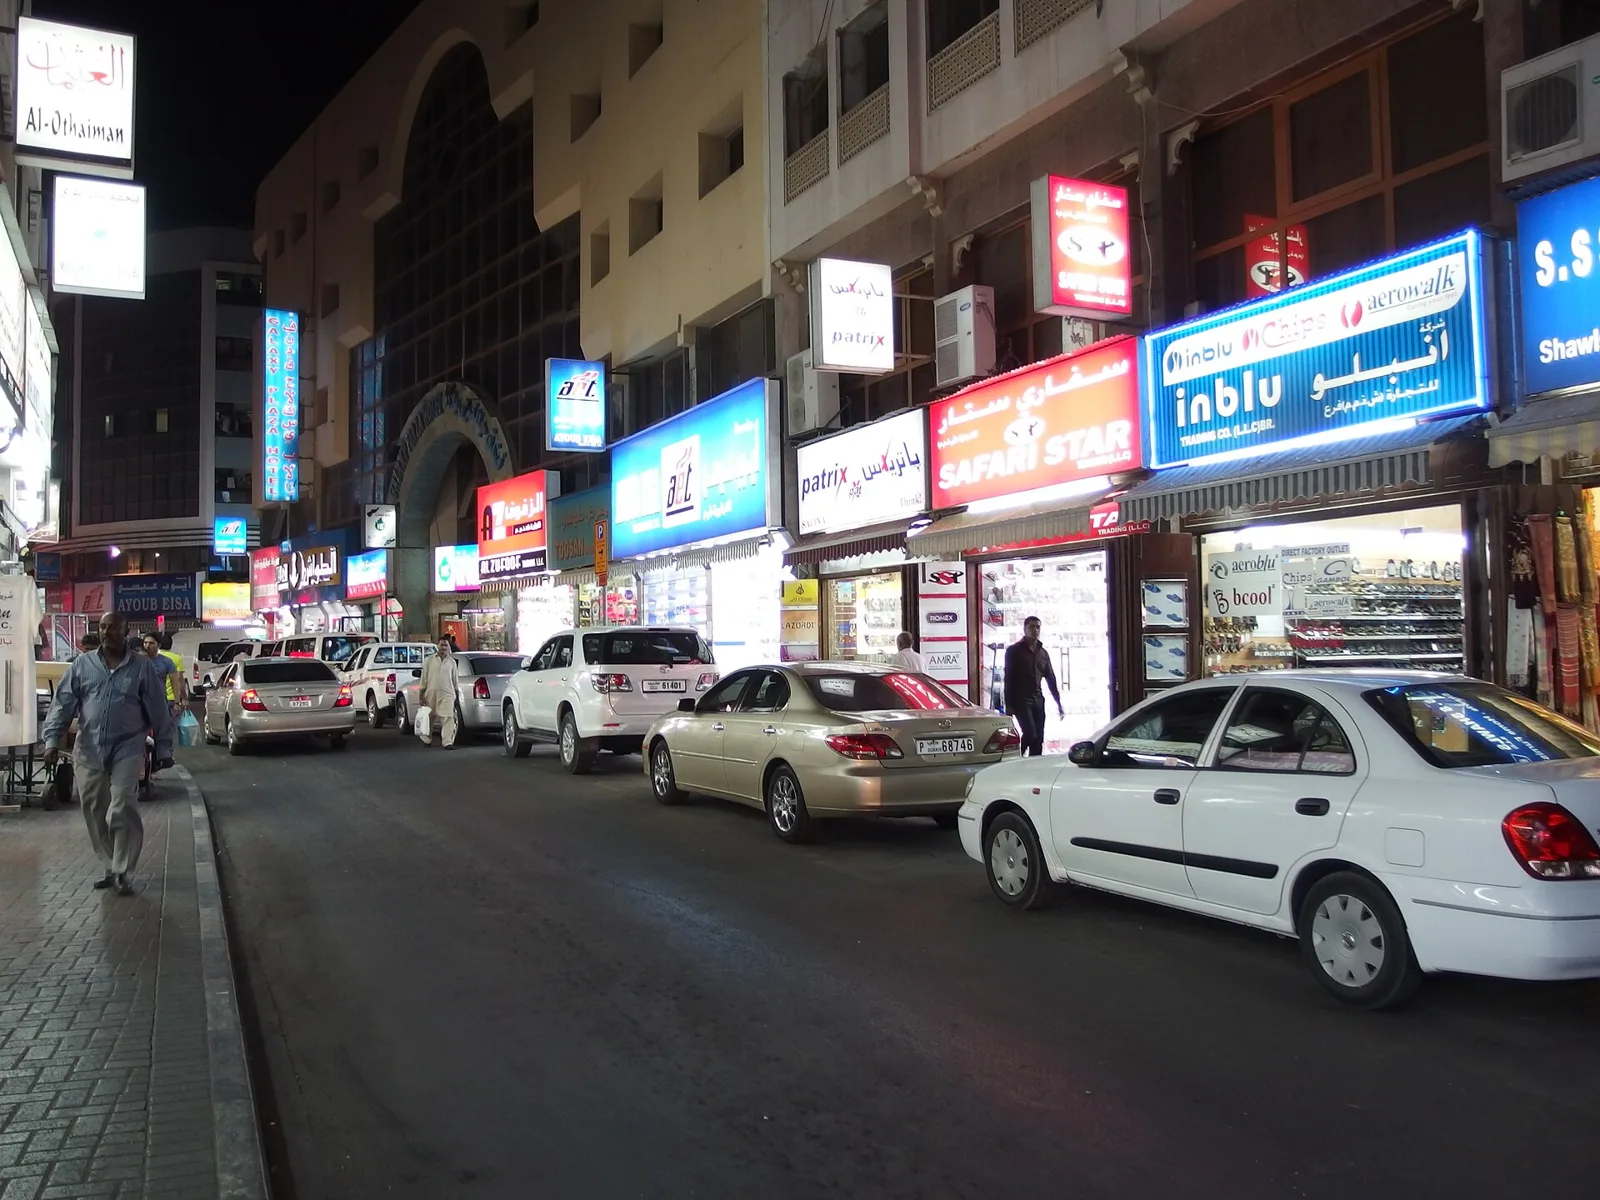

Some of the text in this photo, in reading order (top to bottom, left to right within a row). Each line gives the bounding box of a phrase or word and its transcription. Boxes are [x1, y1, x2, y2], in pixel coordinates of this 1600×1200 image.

[25, 106, 125, 144] Al-Othaiman
[1368, 264, 1455, 310] aerowalk
[267, 317, 279, 374] GALAXY
[832, 330, 885, 353] patrix
[1186, 341, 1233, 368] inblu
[1539, 326, 1600, 364] Shawl
[267, 386, 279, 434] PLAZA
[1176, 370, 1282, 429] inblu
[938, 442, 1038, 490] SAFARI
[1044, 419, 1130, 466] STAR
[267, 447, 279, 496] HOTEL
[801, 462, 848, 503] patrix
[1098, 525, 1127, 537] TRADING
[1232, 554, 1276, 572] aeroblu
[1281, 544, 1350, 557] DIRECT FACTORY OUTLET
[1282, 571, 1313, 585] Chips
[118, 596, 192, 612] AYOUB EISA
[1233, 586, 1271, 606] bcool
[929, 654, 958, 665] AMIRA
[920, 741, 924, 753] P
[942, 738, 973, 752] 68746
